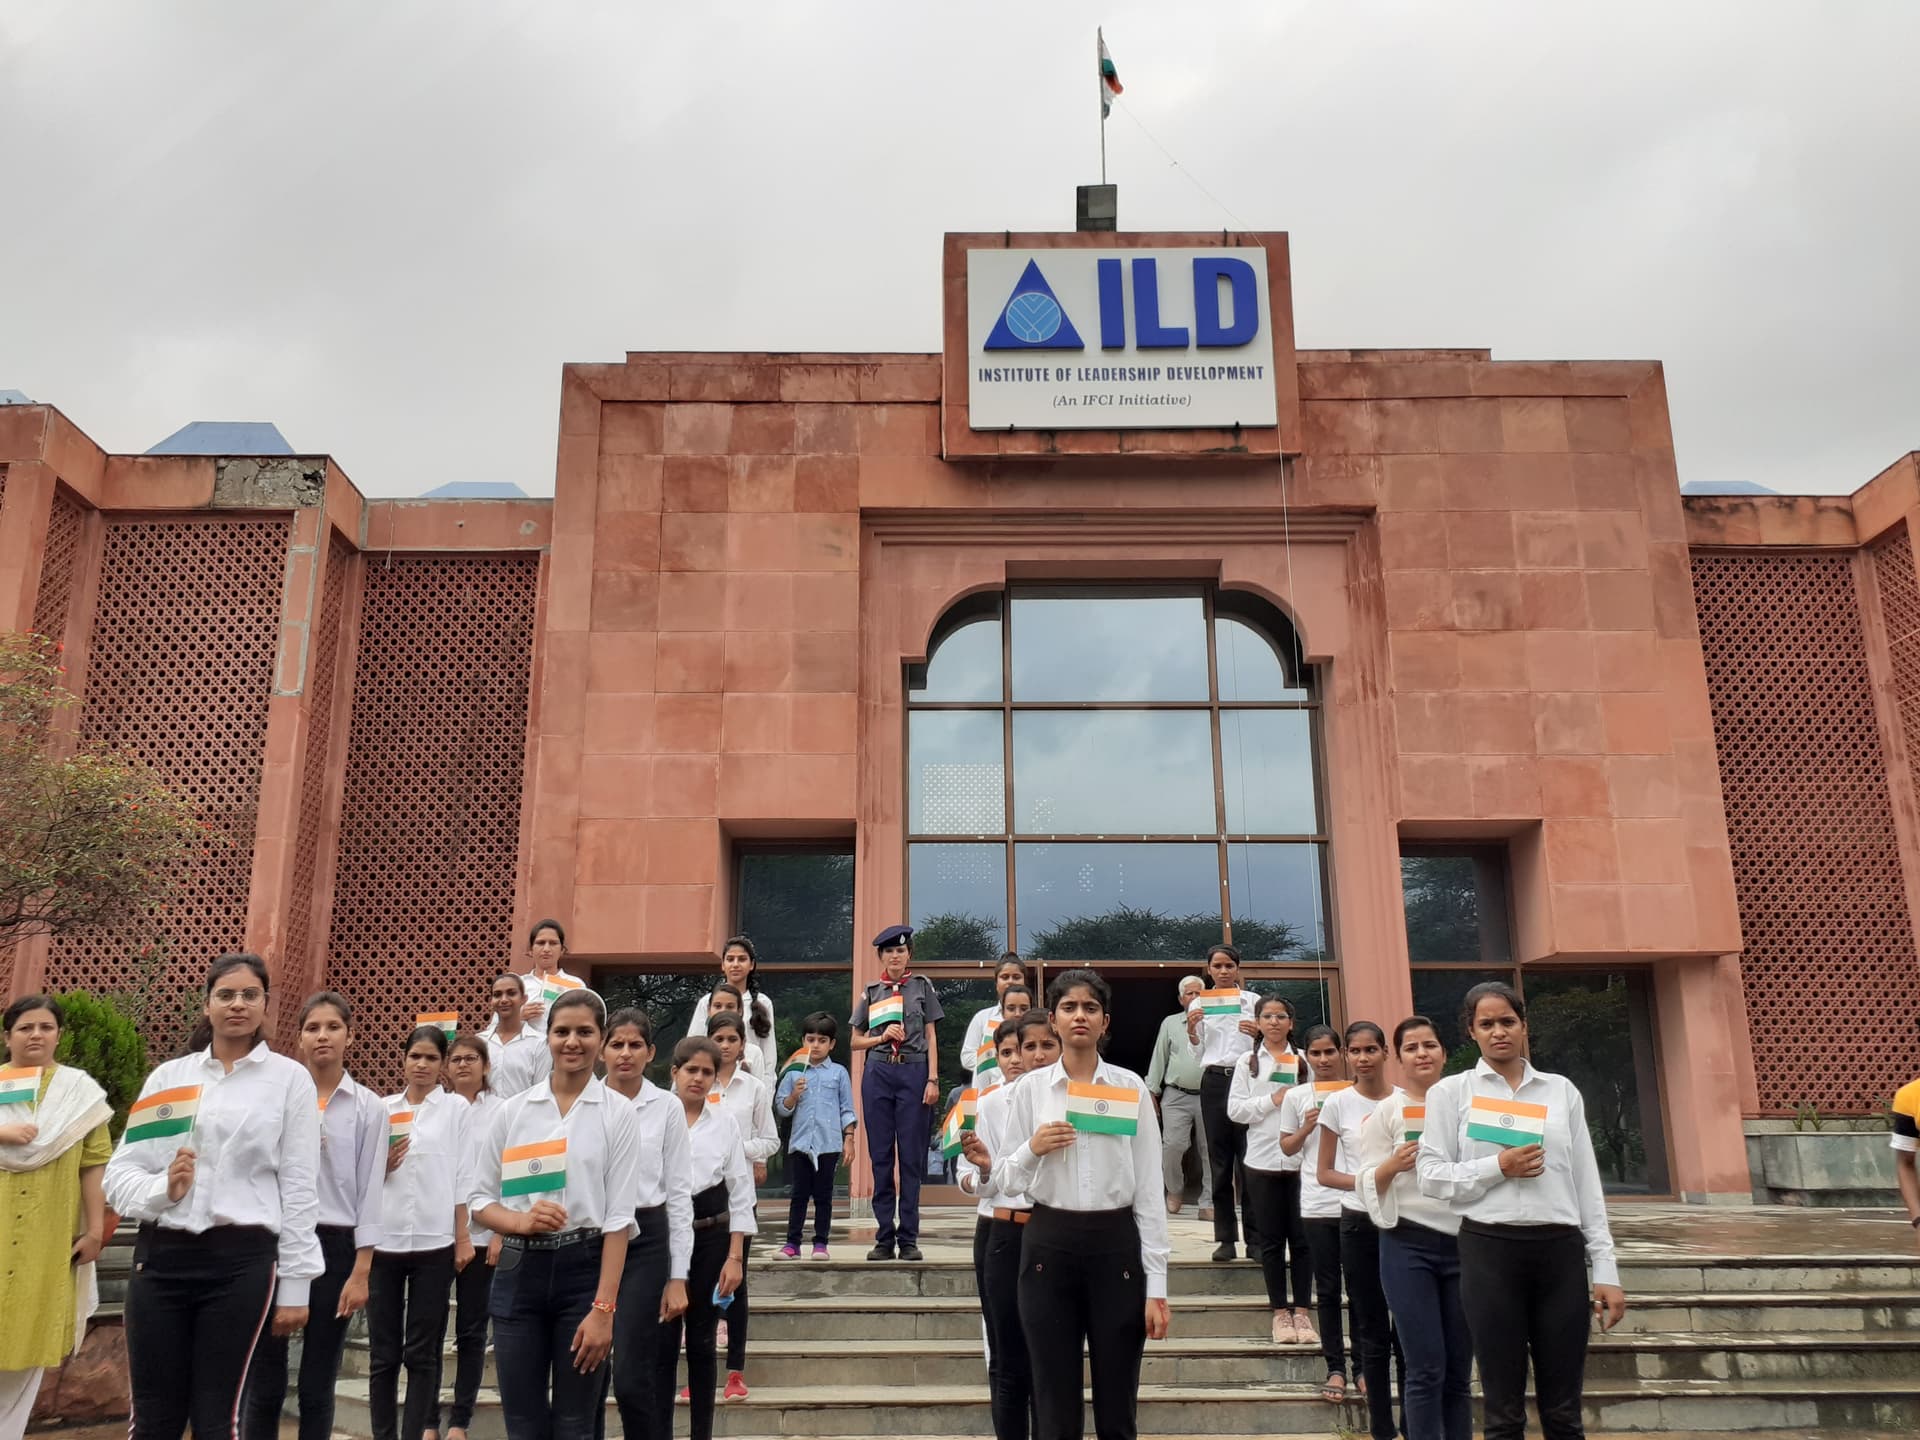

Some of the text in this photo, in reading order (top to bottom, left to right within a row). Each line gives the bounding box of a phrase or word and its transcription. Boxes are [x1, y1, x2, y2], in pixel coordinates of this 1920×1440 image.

[1097, 257, 1259, 350] ILD
[978, 365, 1264, 382] INSTITUTE OF LEADERSHIP DEVELOPMENT
[1052, 393, 1192, 408] (An IFCI Initiative)
